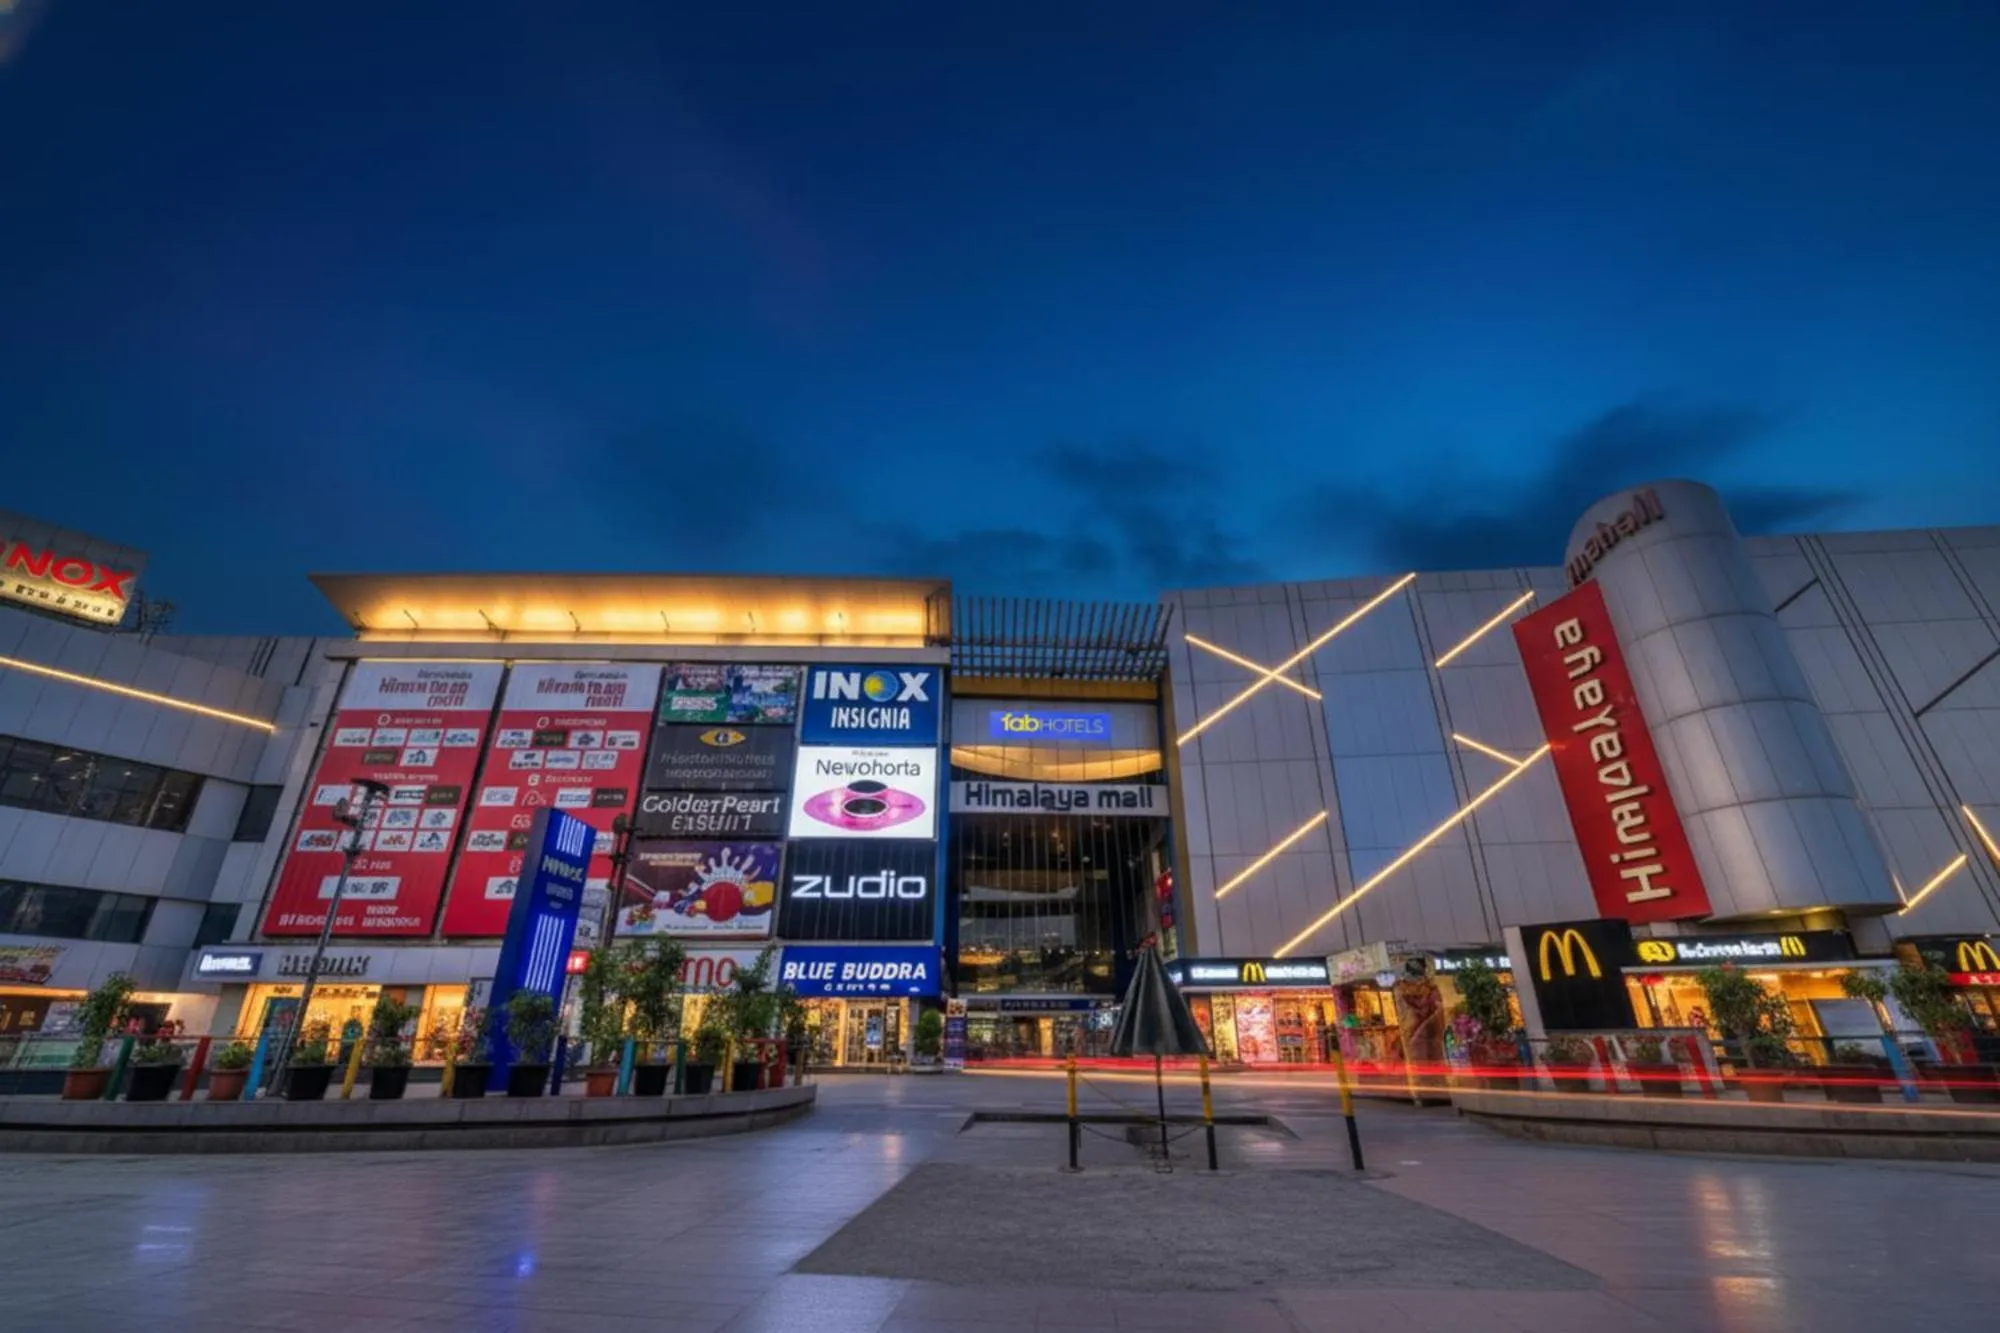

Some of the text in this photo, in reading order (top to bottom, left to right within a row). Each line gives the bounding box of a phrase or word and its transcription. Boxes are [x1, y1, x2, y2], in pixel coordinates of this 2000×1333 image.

[0, 540, 134, 602] NOX
[813, 671, 931, 702] INOX
[831, 706, 911, 730] INSIGNIA
[965, 783, 1089, 811] Himalaya
[783, 961, 836, 980] BLUE
